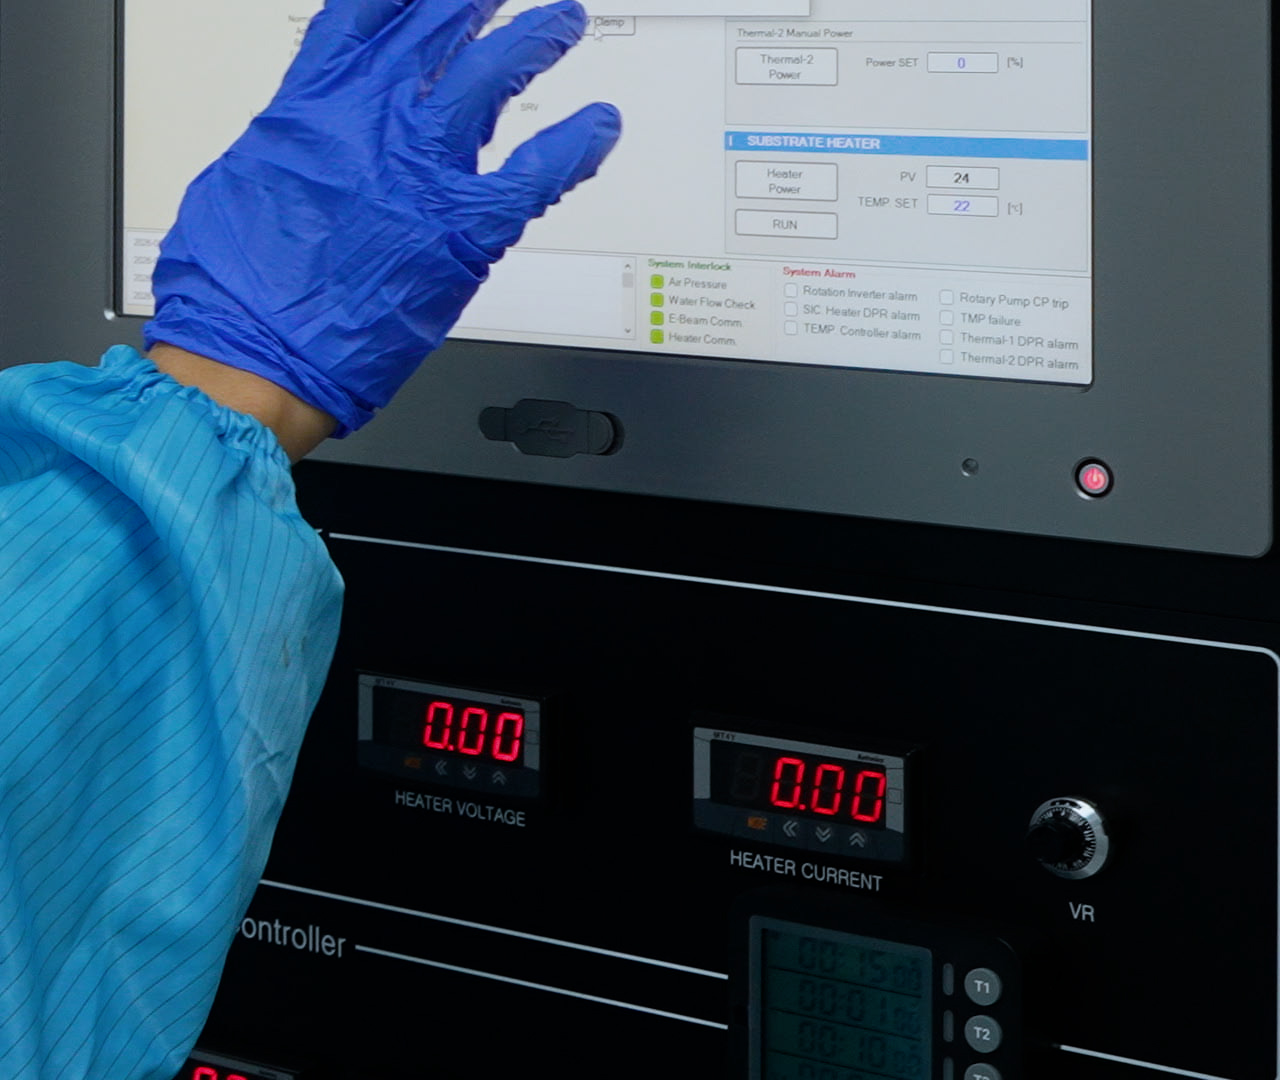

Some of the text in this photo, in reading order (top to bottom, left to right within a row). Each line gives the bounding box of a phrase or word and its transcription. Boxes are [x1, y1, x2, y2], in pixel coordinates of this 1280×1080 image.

[738, 29, 853, 38] Thermal-2 Manual Power
[761, 54, 814, 64] Thermal-2
[866, 58, 918, 68] Power SET
[769, 70, 801, 80] Power
[748, 136, 880, 149] SUBSTRATE HEATER
[767, 169, 802, 179] Heater
[900, 172, 970, 184] PV 24
[769, 184, 800, 194] Power
[894, 198, 918, 208] SET
[954, 200, 970, 212] 22
[772, 220, 798, 230] RUN
[648, 258, 731, 271] System Interlock
[783, 266, 856, 279] System Alarm
[669, 277, 727, 289] Air Pressure
[803, 286, 918, 301] Rotation Inverter alarm
[669, 296, 755, 309] Water Flow Check
[960, 292, 1069, 310] Rotary Pump CP trip
[669, 314, 708, 325] E-Beam
[826, 307, 861, 318] Heater
[863, 308, 888, 318] DPR
[891, 310, 920, 320] alarm
[962, 312, 1021, 326] TMP failure
[669, 332, 702, 344] Heater
[840, 325, 889, 338] Controller
[891, 329, 921, 340] alarm
[962, 332, 1078, 350] Thermal-1 DPR alarm
[962, 352, 1078, 370] Thermal-2 DPR alarm
[423, 701, 525, 762] 0.00
[770, 757, 886, 823] 0.00
[395, 790, 526, 827] HEATER VOLTAGE
[730, 850, 883, 891] HEATER CURRENT
[1069, 902, 1096, 923] VR
[236, 918, 346, 958] ontroller
[974, 980, 990, 994] T1
[974, 1026, 990, 1040] T2
